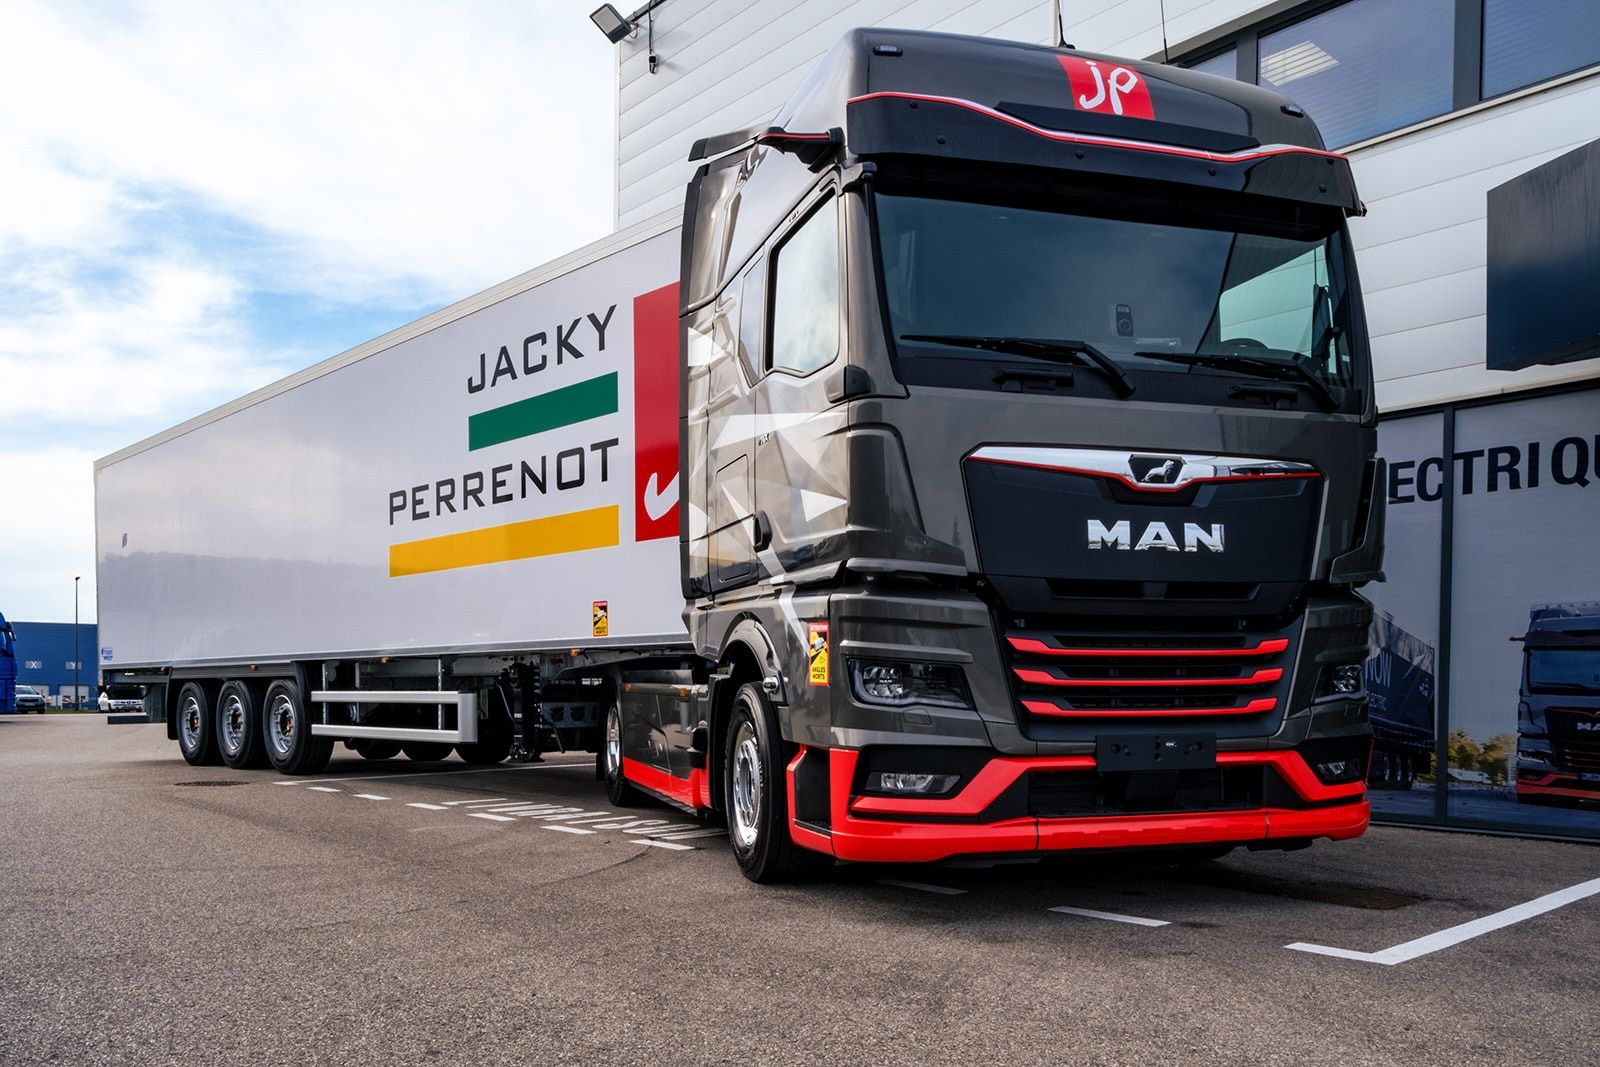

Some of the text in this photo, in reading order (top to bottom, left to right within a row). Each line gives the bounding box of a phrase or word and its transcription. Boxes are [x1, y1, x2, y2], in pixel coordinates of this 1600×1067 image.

[467, 304, 618, 394] JACKY
[389, 437, 620, 526] PERRENOT
[1388, 434, 1600, 504] ECTRIQ
[1087, 519, 1226, 554] MAN
[441, 798, 726, 841] LIVRAISON
